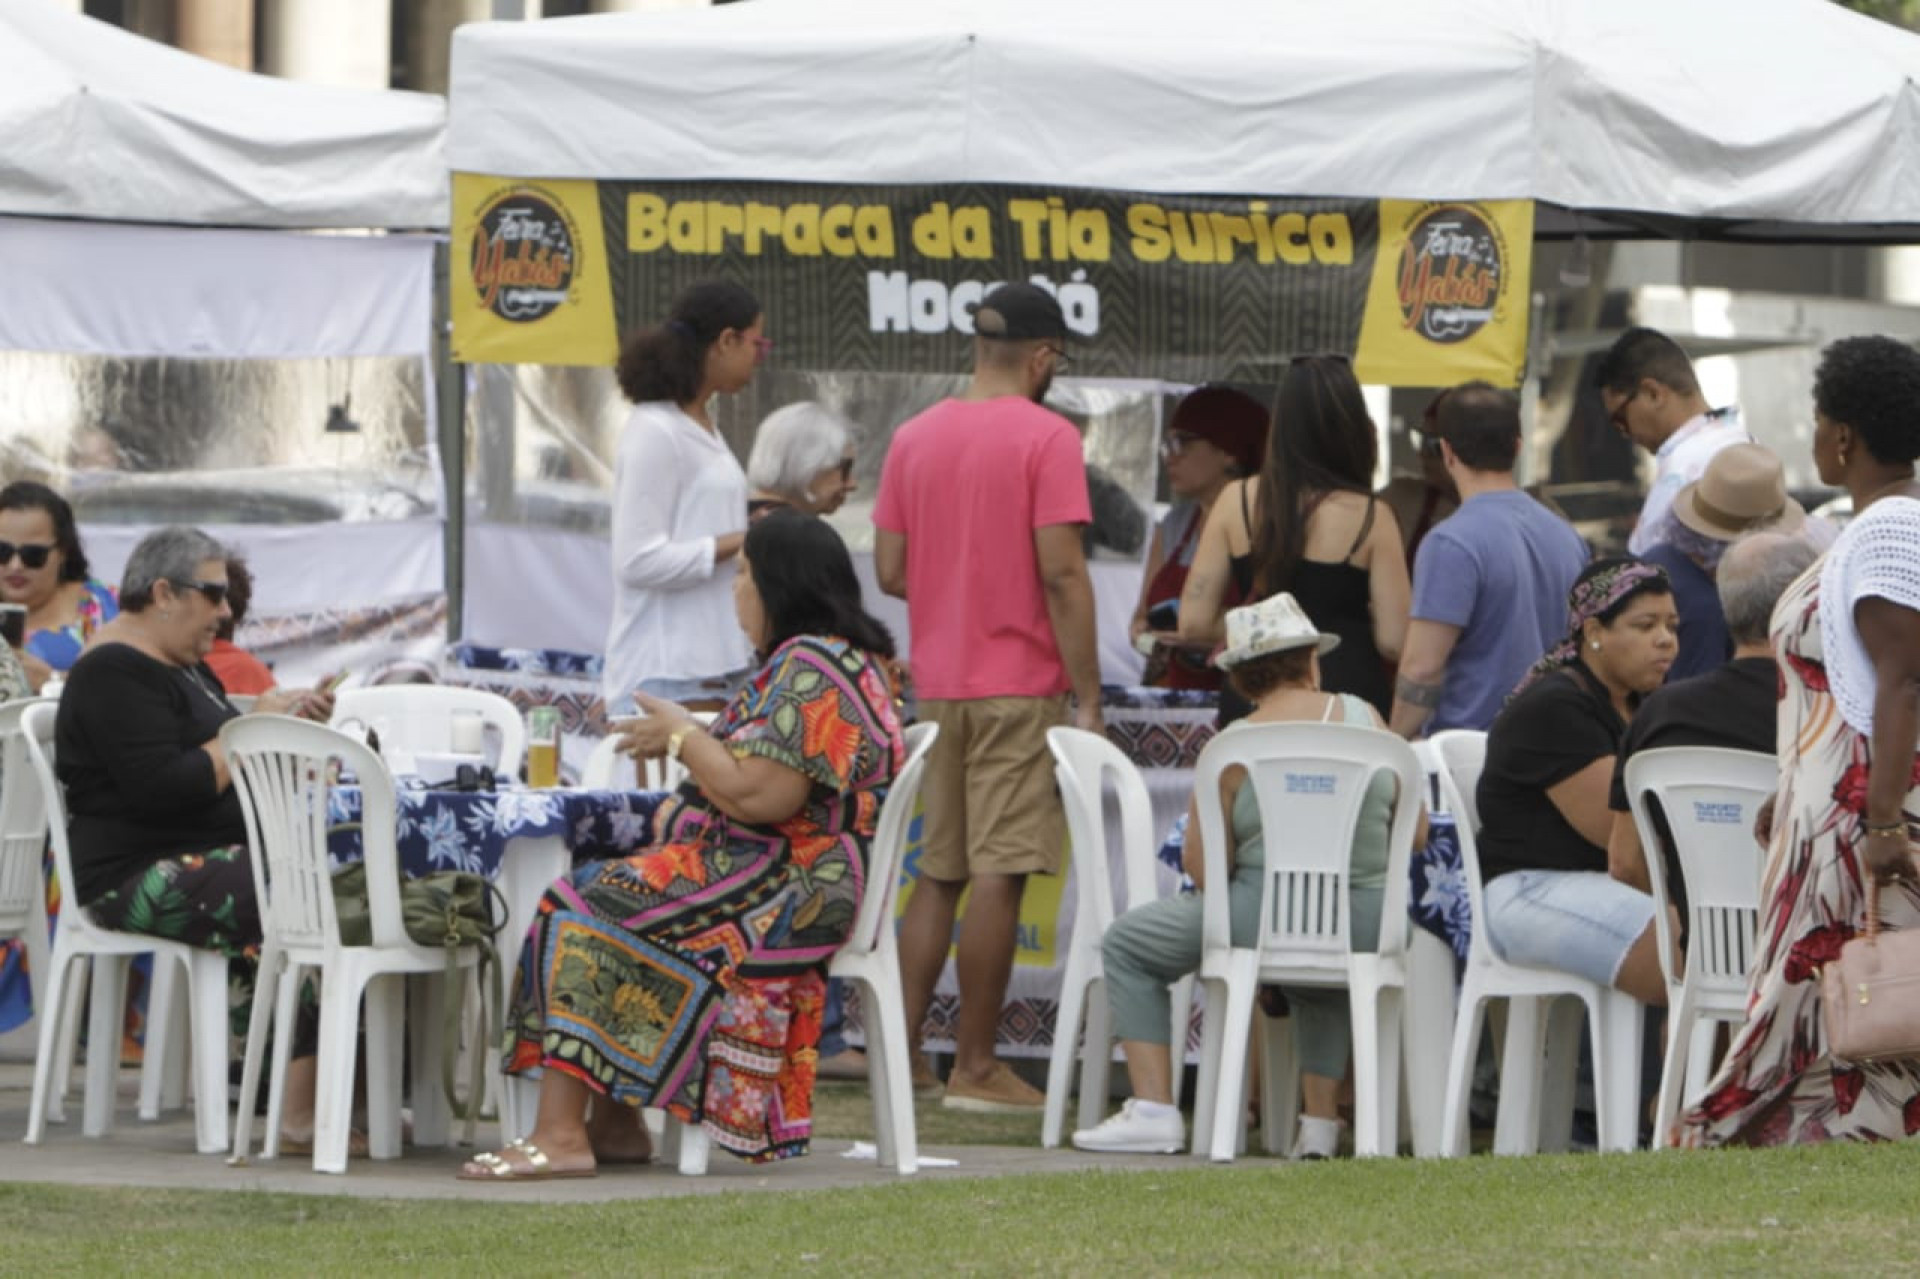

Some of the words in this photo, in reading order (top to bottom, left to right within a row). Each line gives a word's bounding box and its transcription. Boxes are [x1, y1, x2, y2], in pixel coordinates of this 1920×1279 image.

[626, 191, 896, 257] Barraca
[911, 200, 993, 260] da
[1007, 196, 1112, 262] Tia
[1126, 200, 1354, 265] Surica
[866, 267, 1100, 337] Mocó
